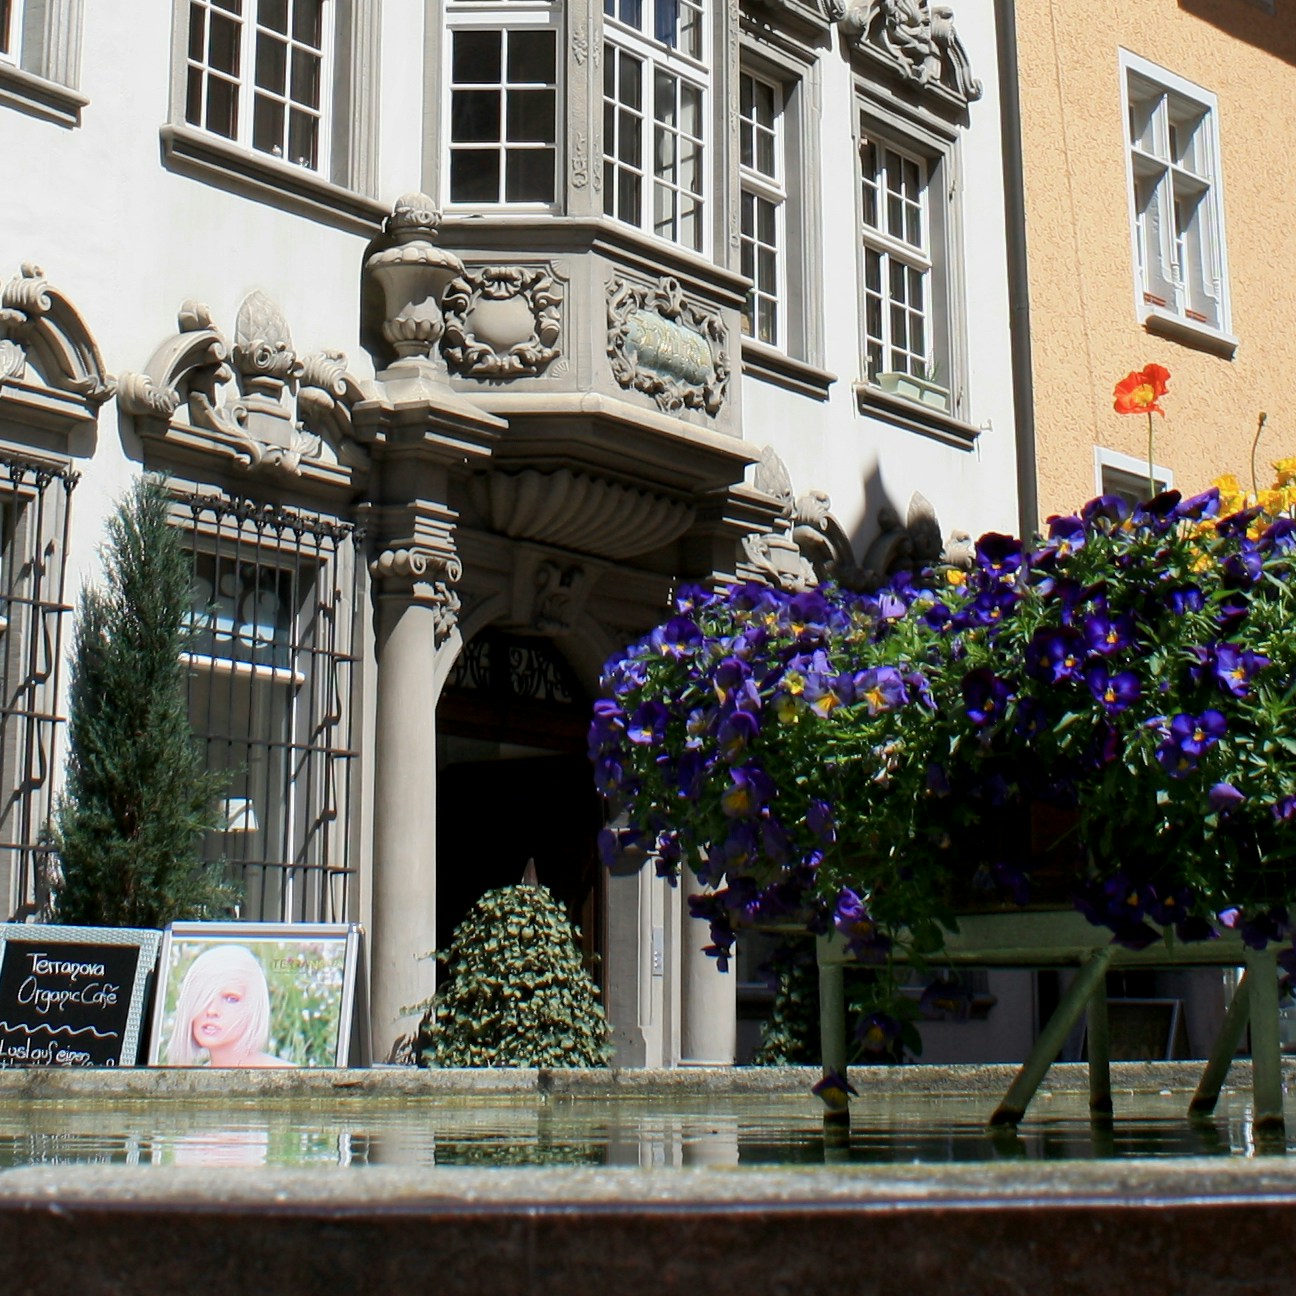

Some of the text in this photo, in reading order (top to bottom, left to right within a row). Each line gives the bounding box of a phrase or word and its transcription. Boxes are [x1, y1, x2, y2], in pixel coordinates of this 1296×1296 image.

[26, 953, 105, 981] Terranova
[18, 976, 120, 1014] Organic Café
